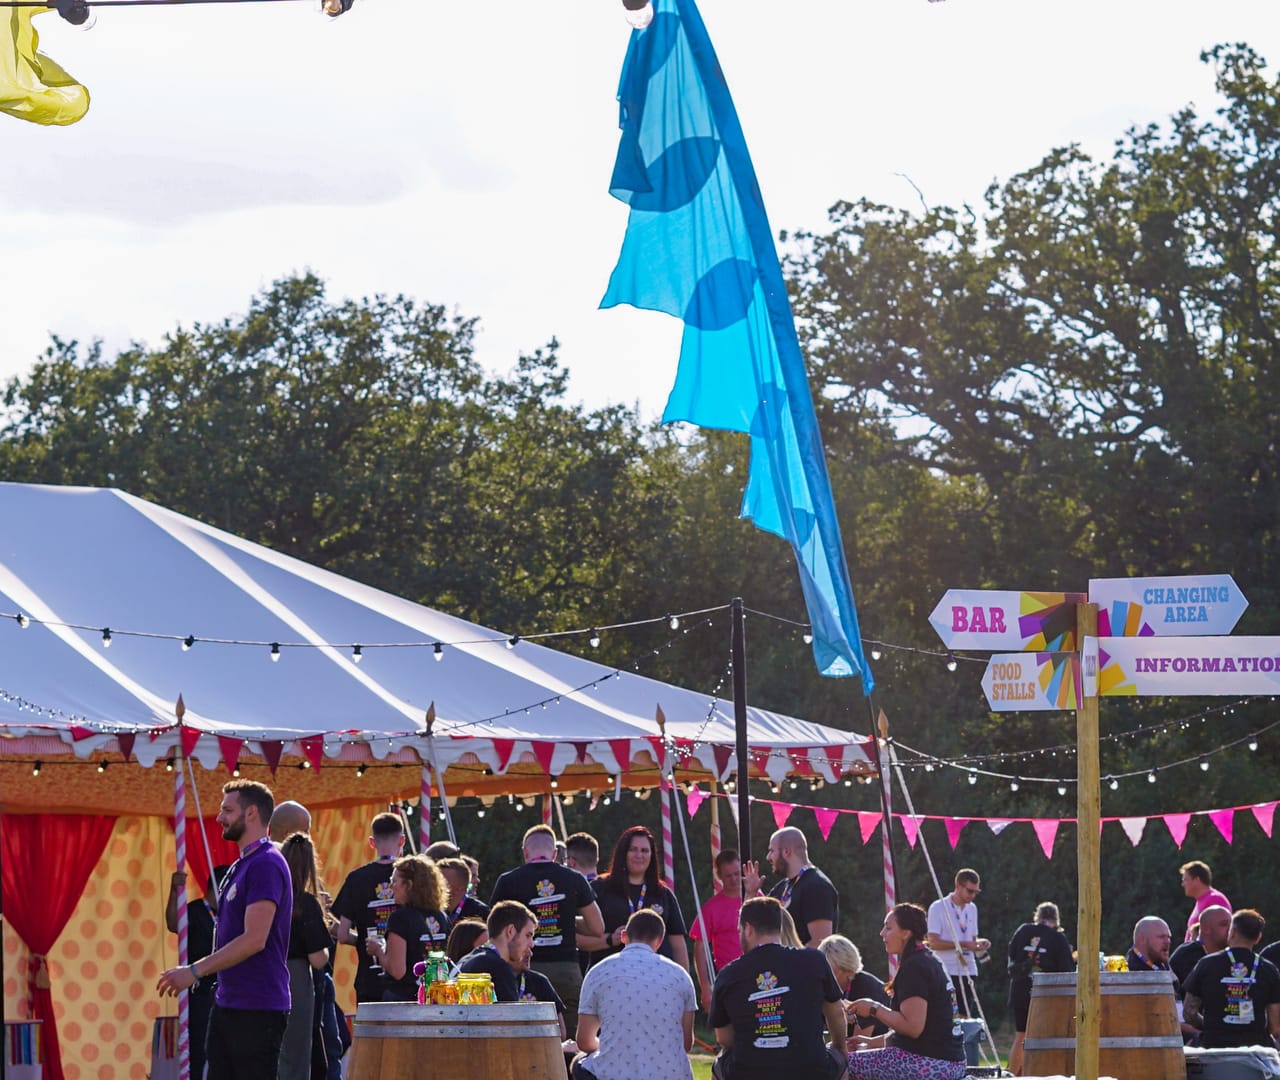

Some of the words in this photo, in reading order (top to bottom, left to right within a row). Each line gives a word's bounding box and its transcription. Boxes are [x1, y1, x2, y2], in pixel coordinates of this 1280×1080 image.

[1143, 586, 1230, 604] CHANGING
[951, 605, 1007, 633] BAR
[1164, 606, 1209, 622] AREA
[992, 663, 1022, 681] FOOD
[992, 682, 1036, 700] STALLS
